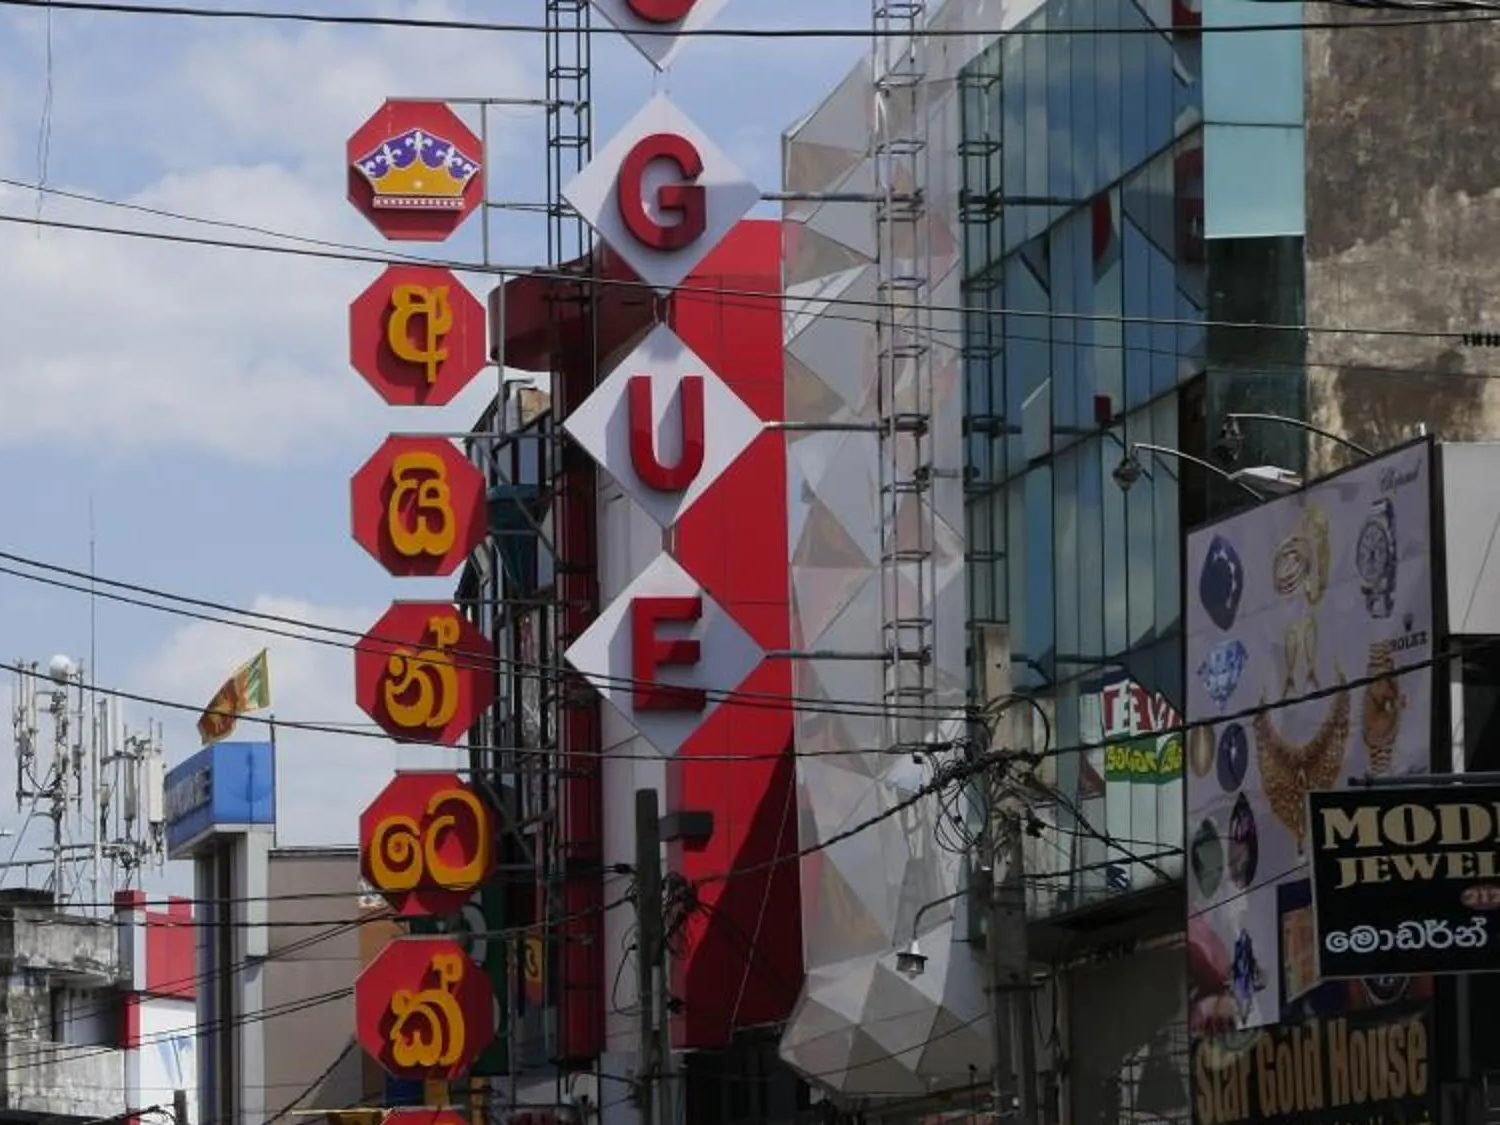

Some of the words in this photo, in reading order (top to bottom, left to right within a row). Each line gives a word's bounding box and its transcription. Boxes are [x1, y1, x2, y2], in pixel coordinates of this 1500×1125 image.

[1319, 802, 1500, 849] MOD
[1257, 1018, 1323, 1117] Gold
[1327, 1016, 1428, 1106] House
